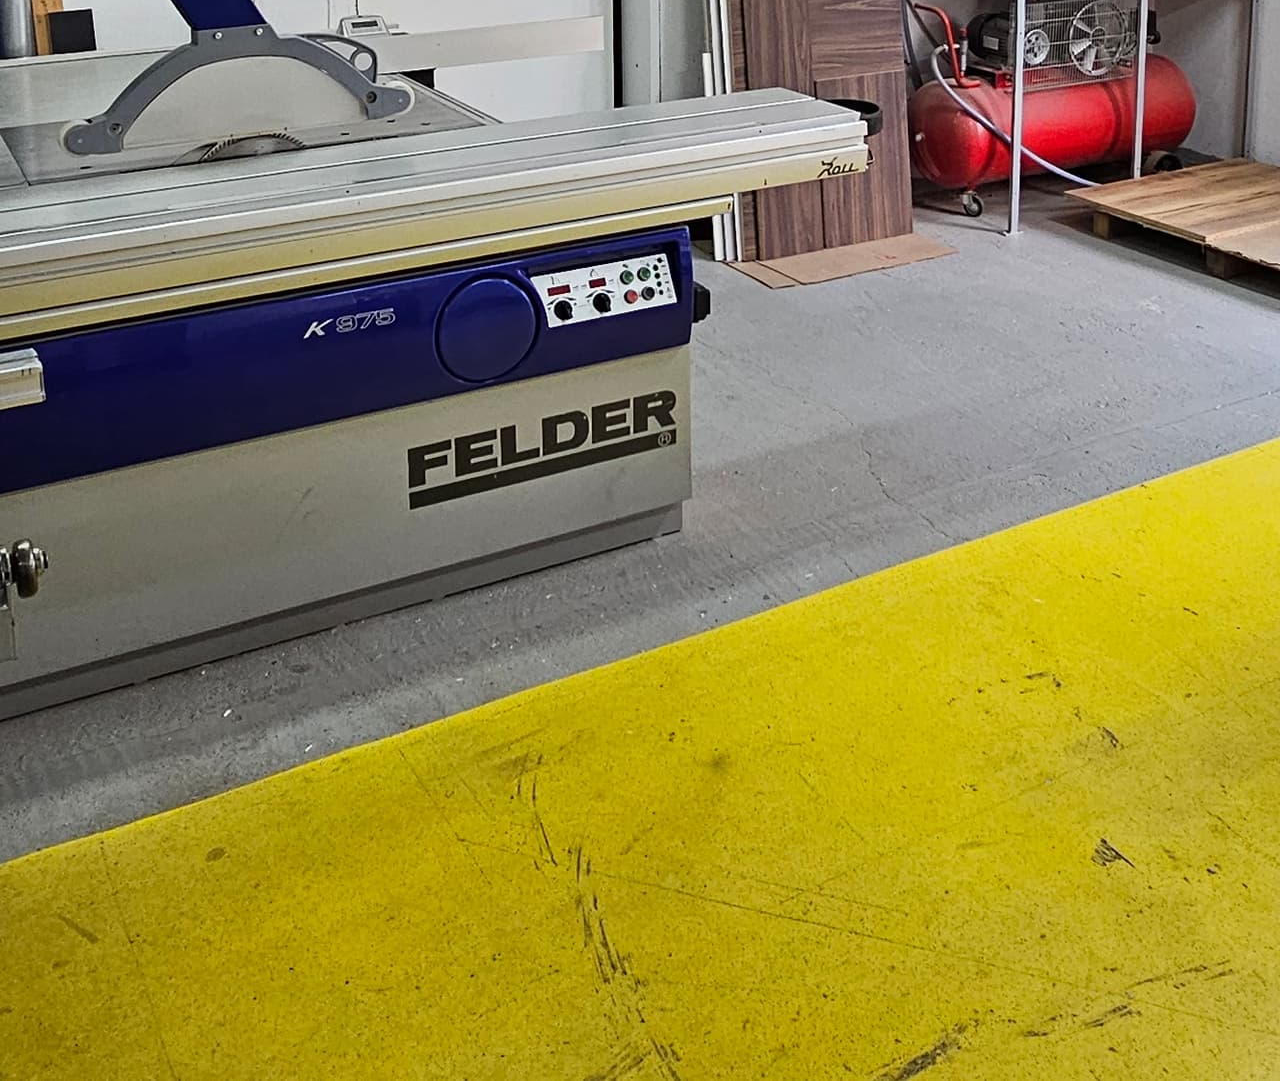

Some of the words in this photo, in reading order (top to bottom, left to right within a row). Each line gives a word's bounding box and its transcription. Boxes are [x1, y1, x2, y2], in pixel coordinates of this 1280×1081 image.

[303, 318, 334, 339] K
[336, 307, 396, 333] 975
[407, 389, 677, 489] FELDER
